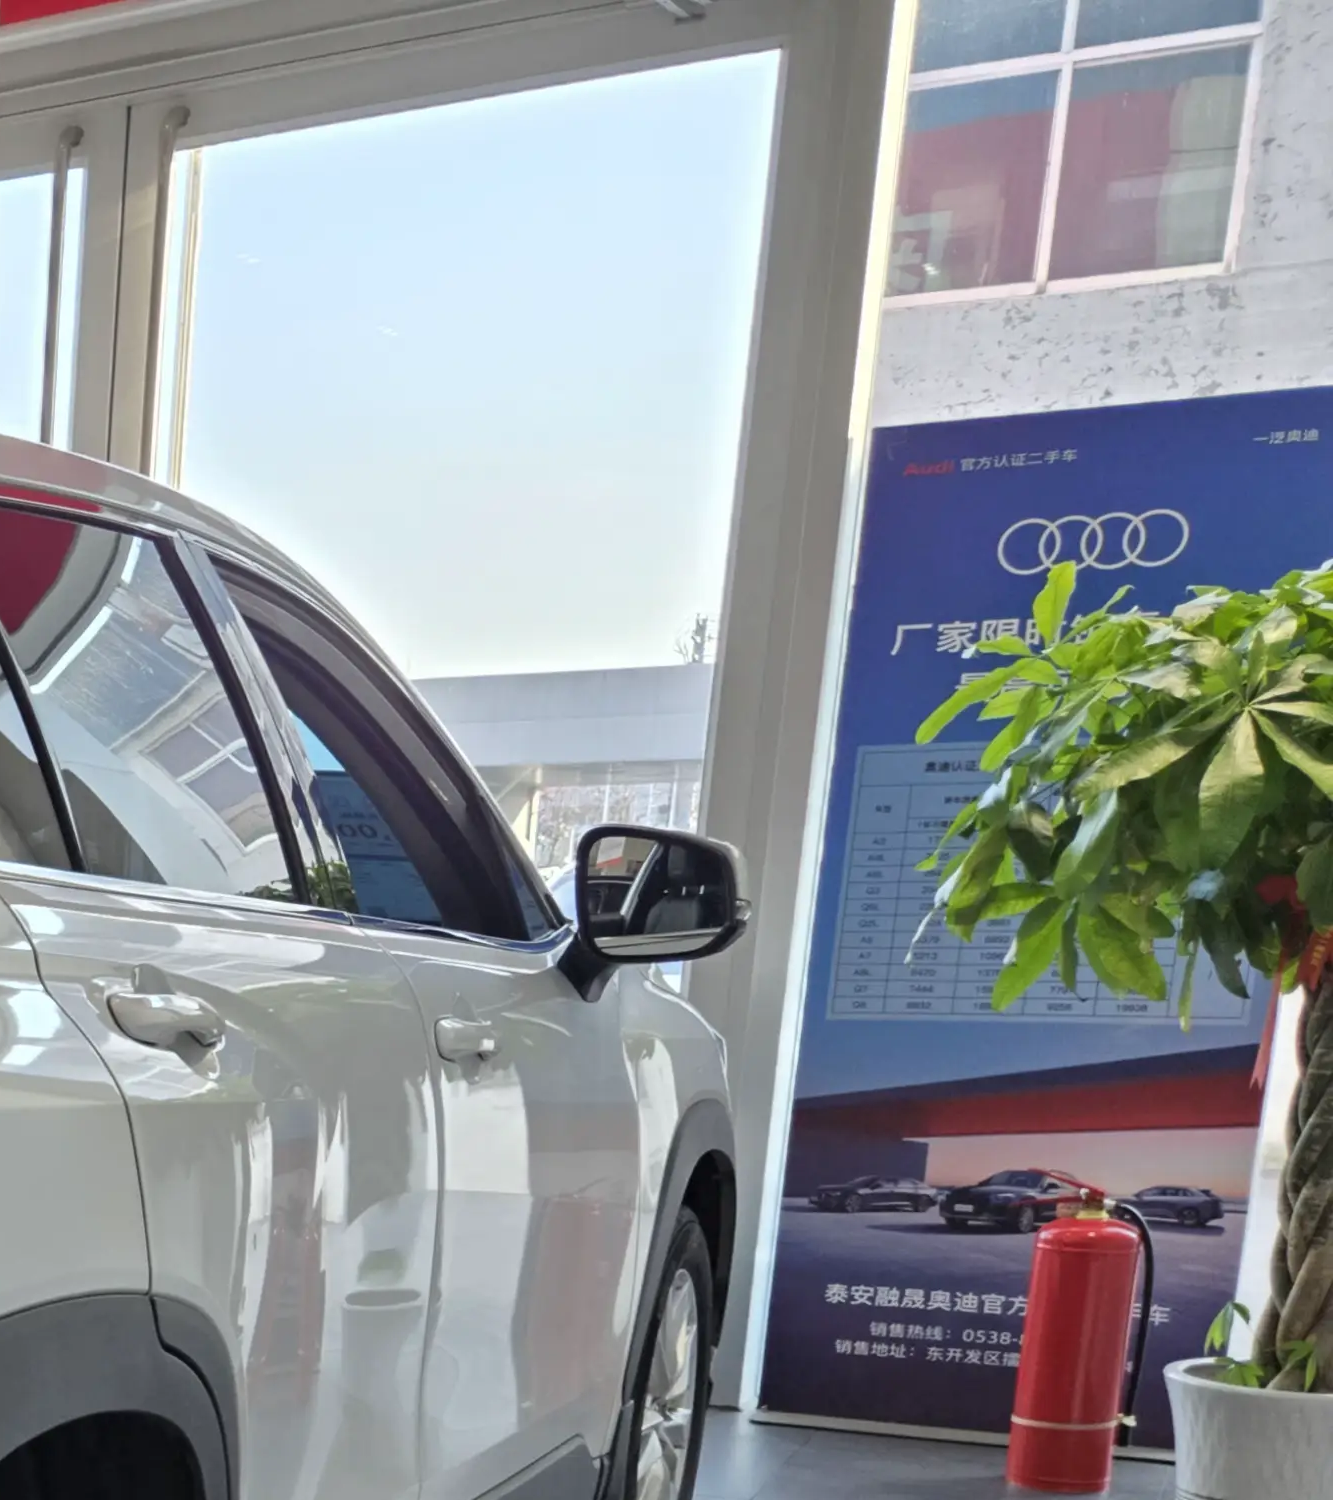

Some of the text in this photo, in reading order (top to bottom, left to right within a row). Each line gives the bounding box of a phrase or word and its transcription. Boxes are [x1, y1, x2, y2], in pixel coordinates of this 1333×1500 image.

[902, 448, 1079, 477] Audi 官方认证二手车
